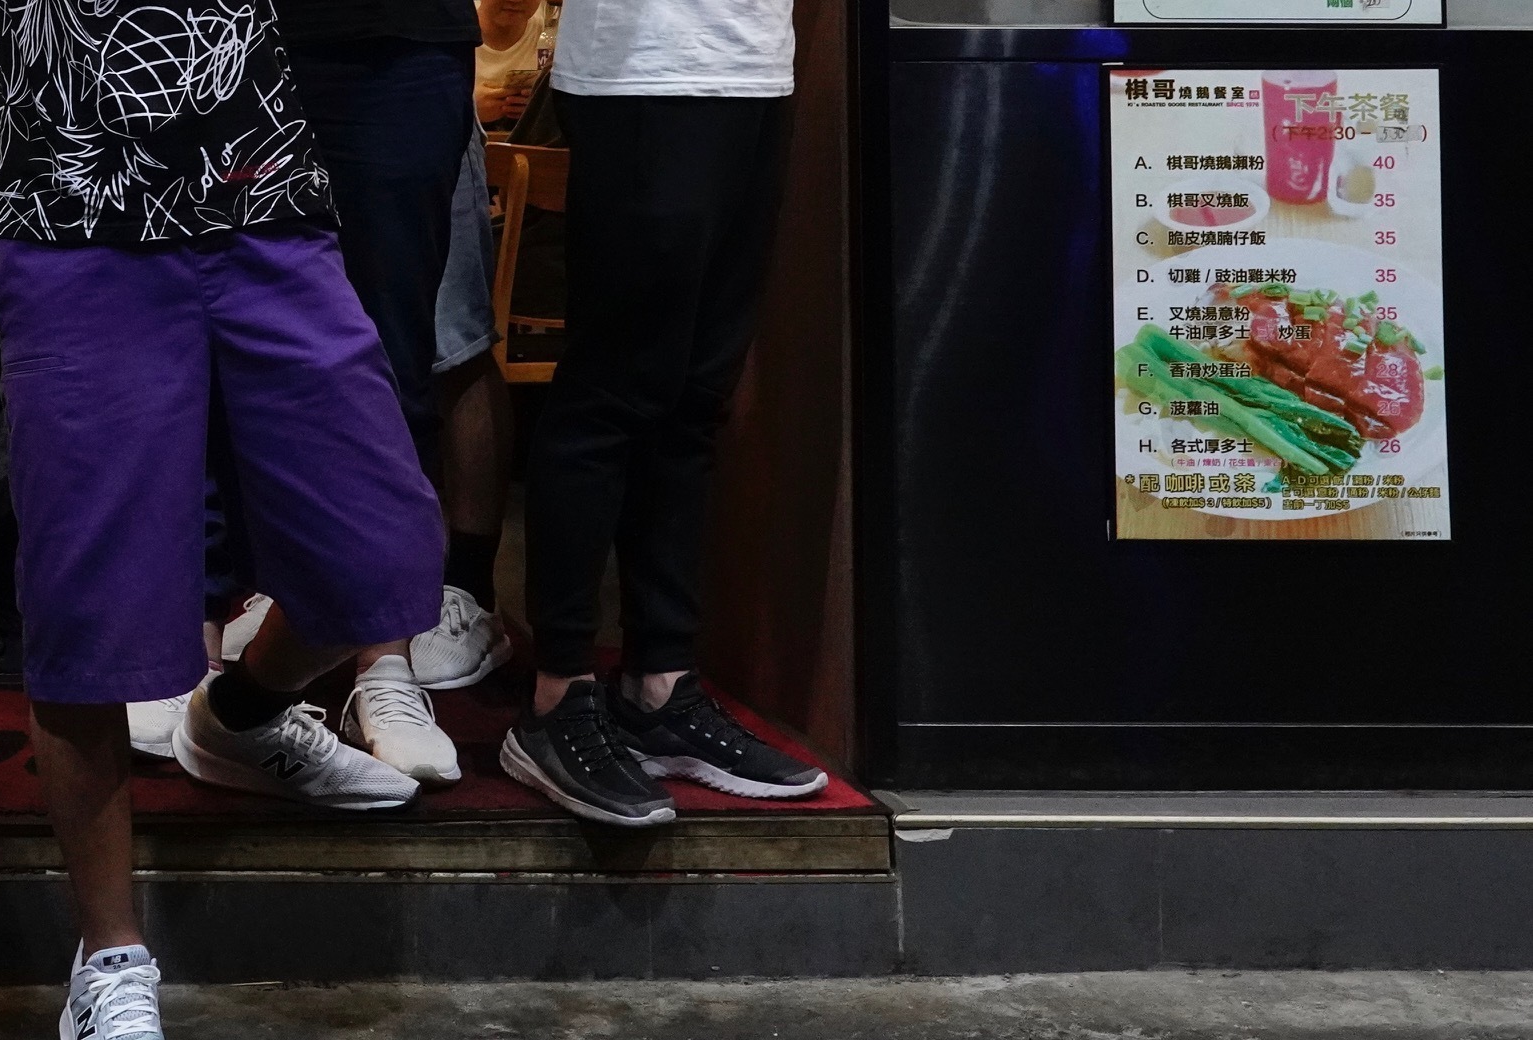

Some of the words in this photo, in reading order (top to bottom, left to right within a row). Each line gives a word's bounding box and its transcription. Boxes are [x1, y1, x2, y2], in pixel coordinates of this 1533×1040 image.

[1125, 78, 1176, 100] 棋哥
[1178, 86, 1245, 100] 燒鵝餐室
[1283, 92, 1410, 123] 下午茶餐
[1135, 156, 1152, 170] A.
[1166, 155, 1265, 171] 棋哥燒鵝瀨粉
[1373, 156, 1395, 170] 40
[1135, 194, 1153, 208] B.
[1167, 193, 1249, 209] 棋哥叉燒飯
[1373, 194, 1395, 208] 35
[1136, 231, 1154, 246] C.
[1167, 230, 1266, 246] 脆皮燒腩仔飯
[1374, 231, 1396, 245] 35
[1137, 269, 1154, 283] D.
[1168, 268, 1201, 284] 切雞
[1215, 268, 1296, 284] 豉油雞米粉
[1375, 269, 1397, 283] 35
[1137, 307, 1154, 321] E.
[1169, 306, 1251, 321] 叉燒湯意粉
[1376, 306, 1398, 320] 35
[1169, 324, 1251, 340] 牛油厚多士
[1278, 324, 1312, 340] 炒蛋
[1138, 364, 1154, 378] F.
[1169, 362, 1252, 378] 香滑炒蛋治
[1376, 363, 1399, 378] 28
[1139, 401, 1157, 416] G.
[1170, 400, 1219, 416] 菠蘿油
[1377, 401, 1400, 416] 26
[1139, 440, 1157, 453] H.
[1171, 438, 1253, 454] 各式厚多士
[1379, 439, 1401, 454] 26
[1139, 474, 1160, 492] 配
[1165, 474, 1205, 492] 咖啡
[1209, 474, 1230, 492] 或
[1234, 474, 1256, 492] 茶
